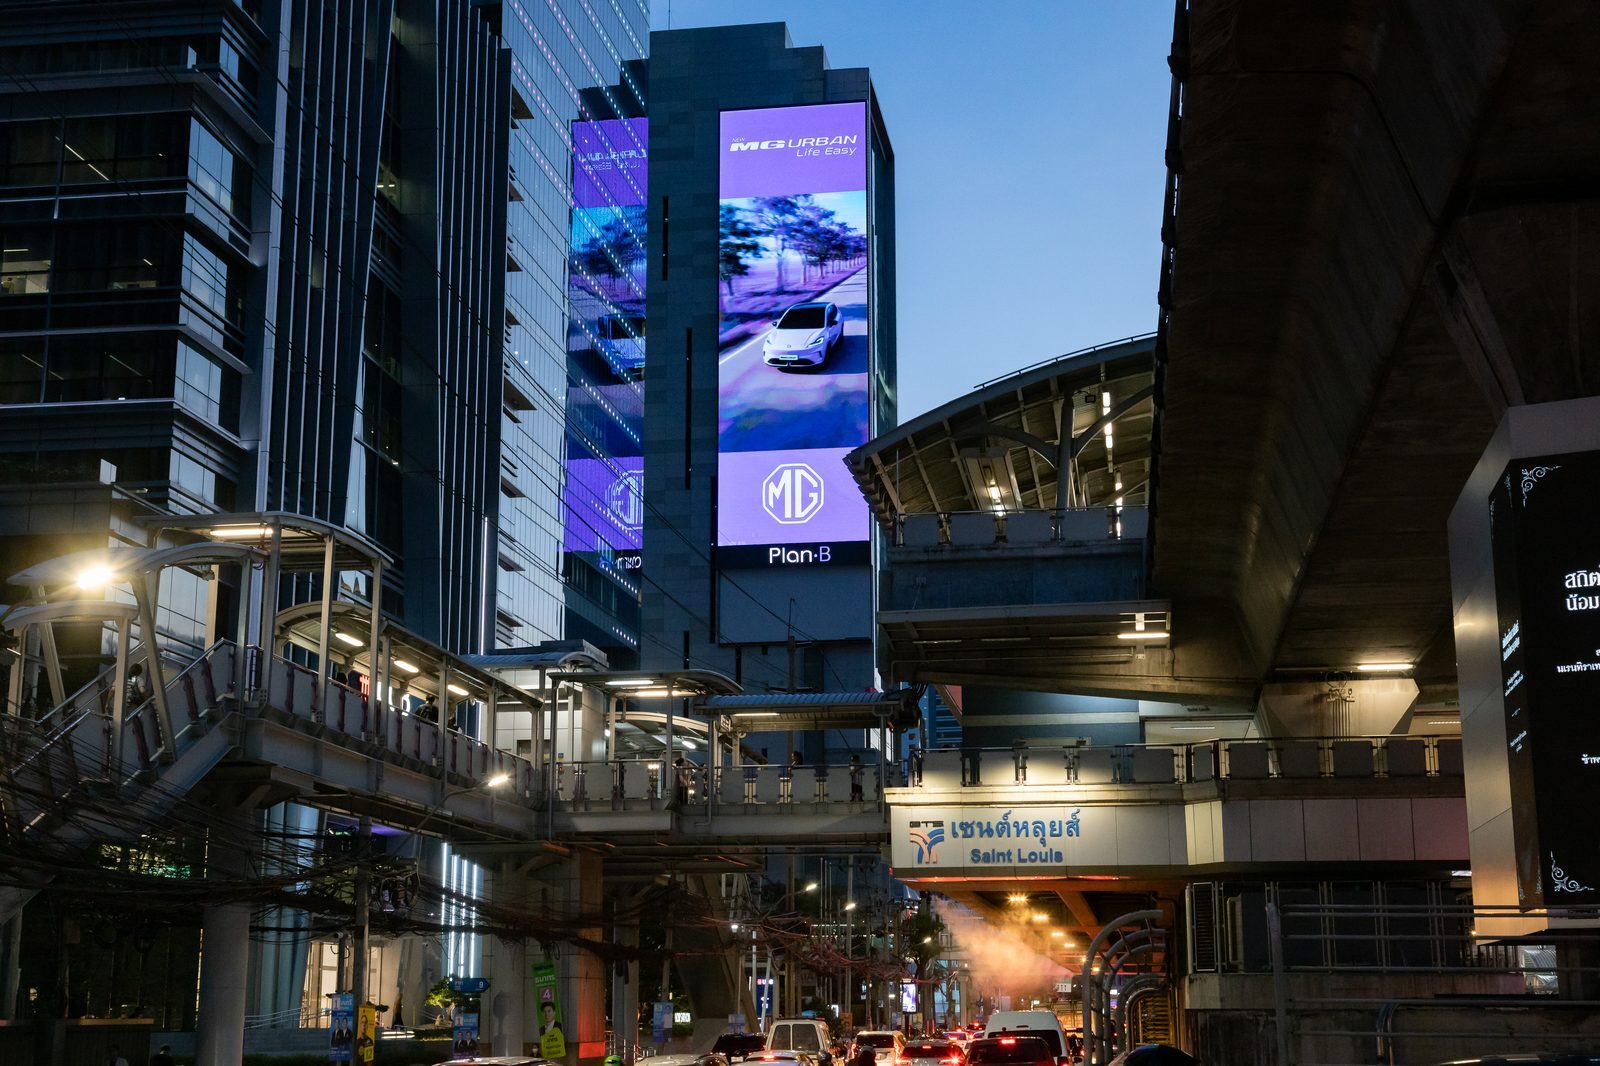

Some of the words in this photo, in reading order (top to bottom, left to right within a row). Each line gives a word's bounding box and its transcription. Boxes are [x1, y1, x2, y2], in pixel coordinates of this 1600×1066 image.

[730, 139, 785, 152] MG
[788, 135, 857, 148] URBAN
[797, 147, 821, 157] Life
[824, 146, 857, 156] Easy
[767, 468, 819, 519] MG
[951, 809, 1081, 847] เซนต์หลุยส์
[970, 848, 1012, 864] Saint
[1017, 848, 1063, 864] Louis
